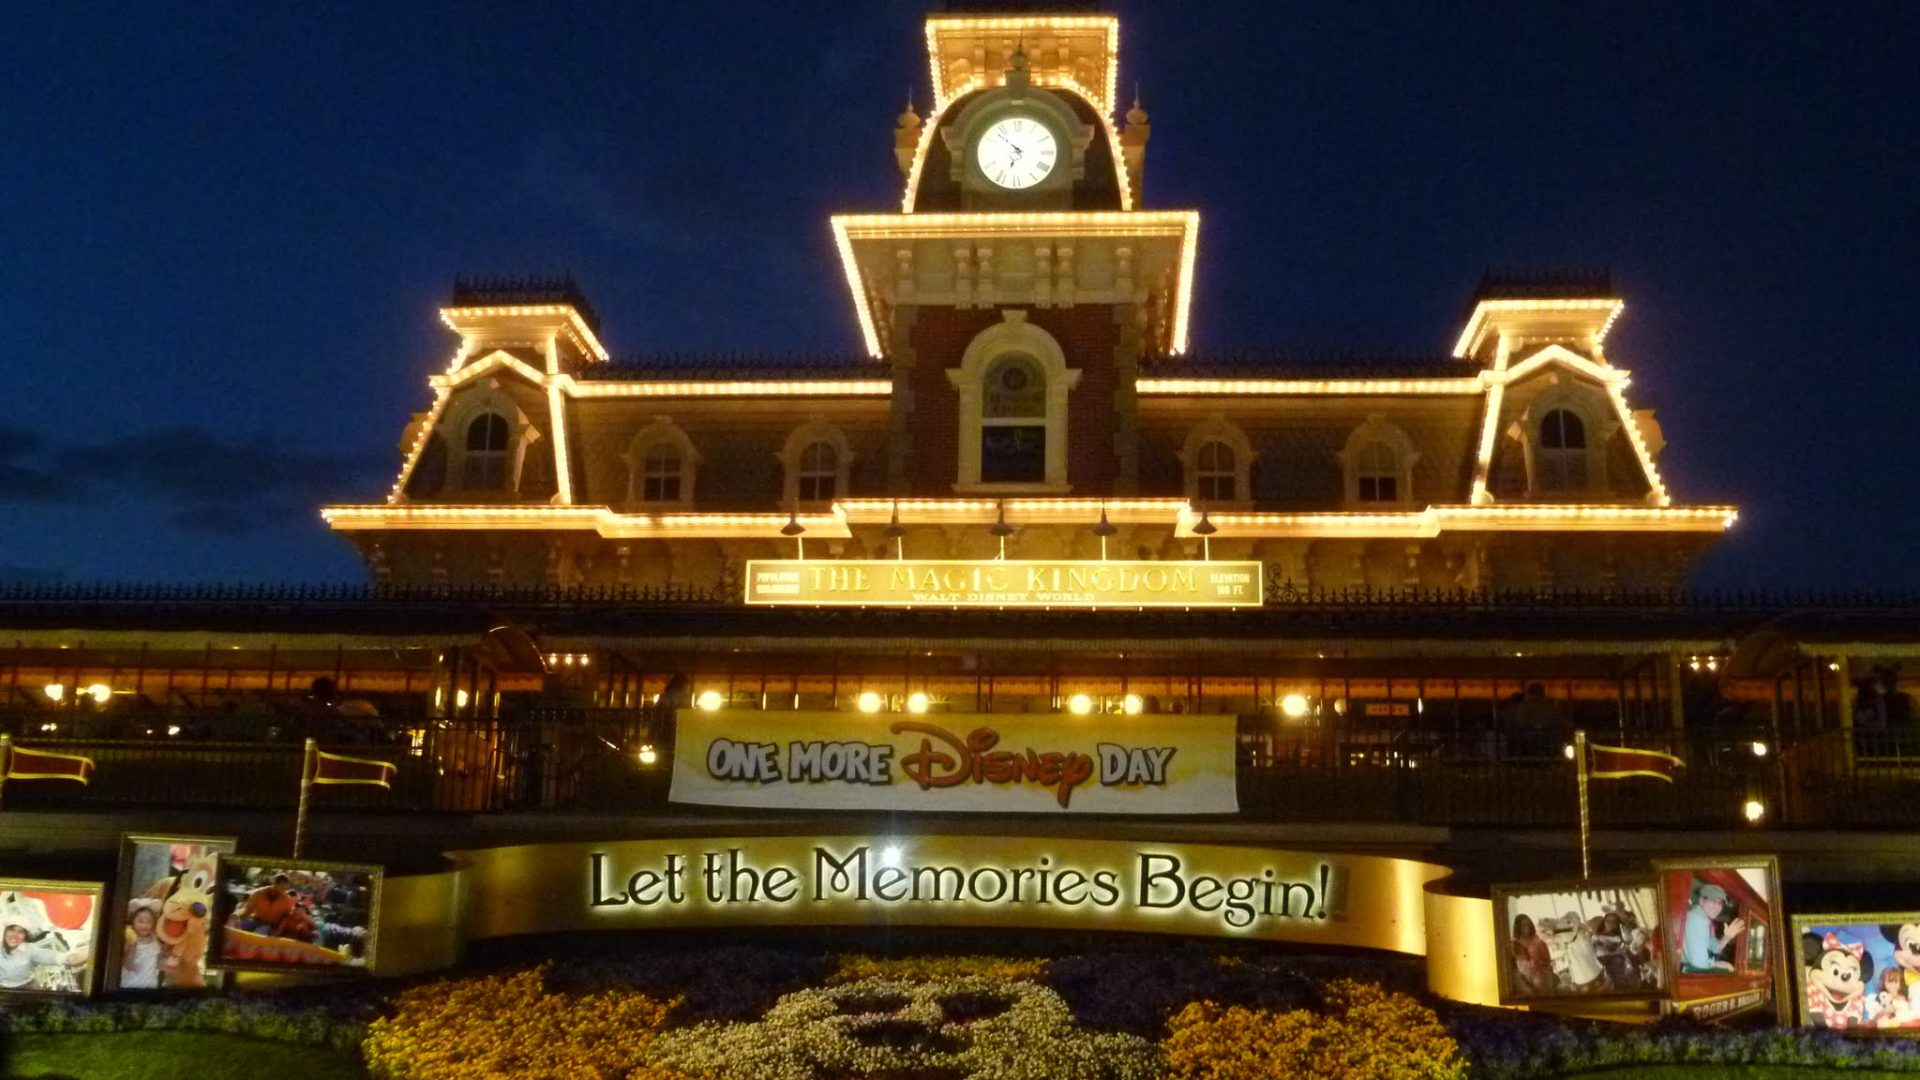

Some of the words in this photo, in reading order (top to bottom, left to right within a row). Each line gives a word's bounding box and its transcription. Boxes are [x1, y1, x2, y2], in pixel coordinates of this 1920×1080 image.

[807, 567, 871, 592] THE
[887, 567, 1009, 592] MAGIC
[1026, 567, 1200, 593] KINGDOM
[1210, 573, 1250, 584] ELEVATION
[912, 592, 960, 602] WALT
[967, 592, 1029, 602] DISNEY
[1036, 592, 1095, 602] WORLD
[706, 738, 782, 784] ONE
[787, 741, 894, 785] MORE
[1097, 742, 1176, 785] DAY
[589, 852, 686, 907] Let
[703, 848, 798, 904] the
[814, 846, 1119, 907] Memories
[1137, 853, 1330, 928] Begin!
